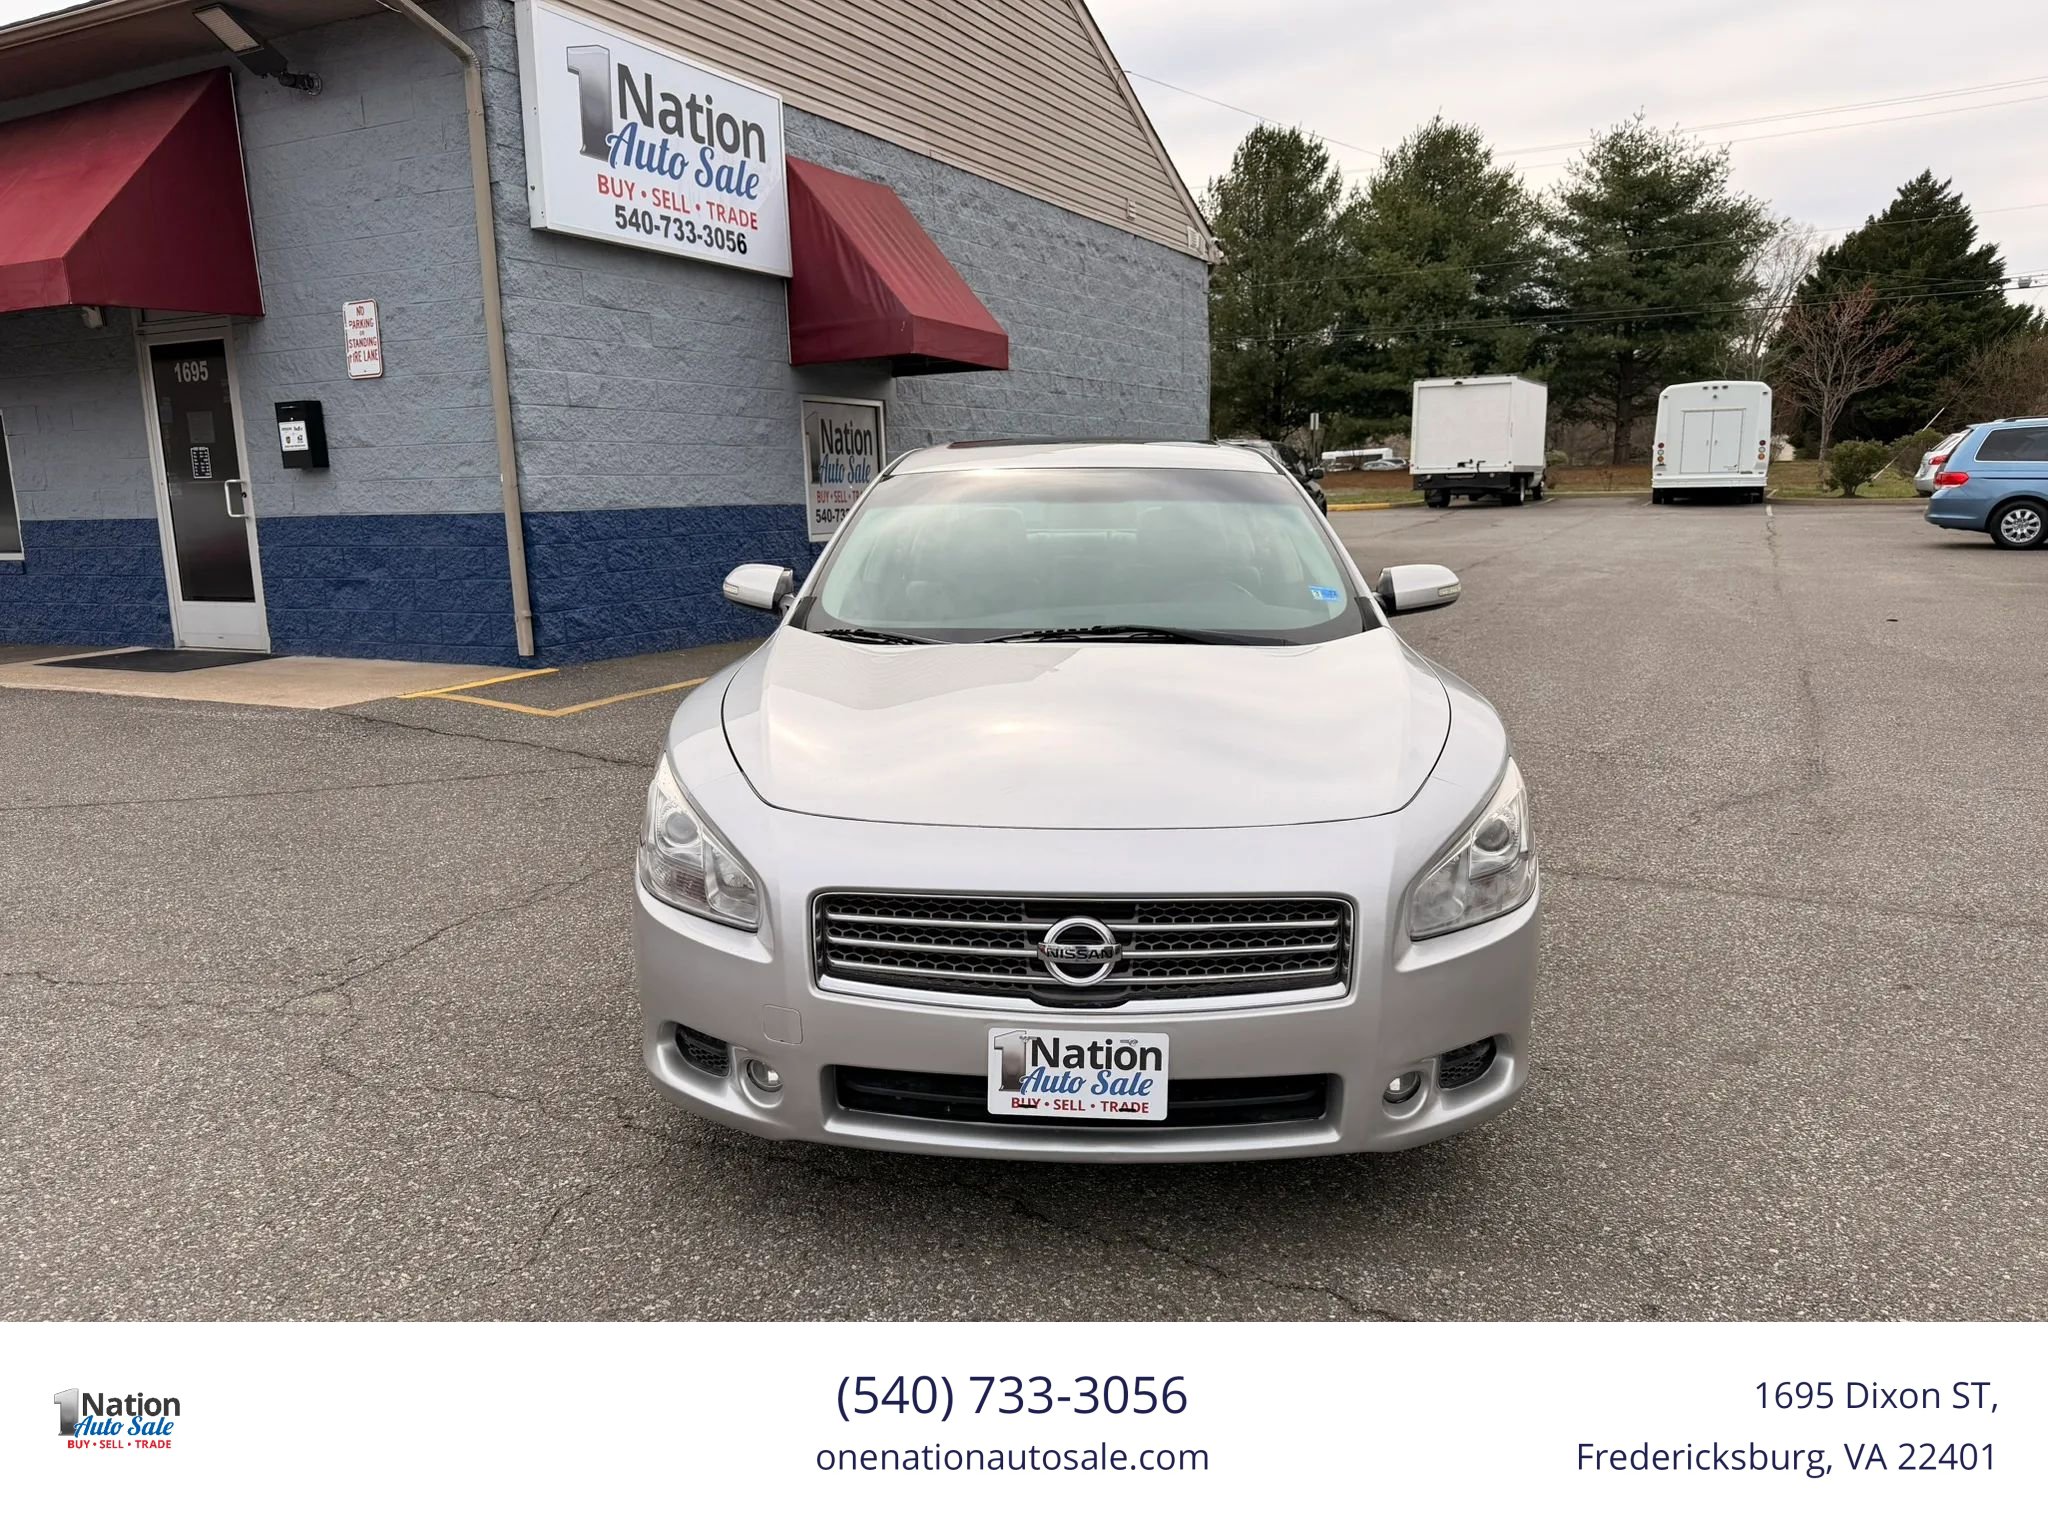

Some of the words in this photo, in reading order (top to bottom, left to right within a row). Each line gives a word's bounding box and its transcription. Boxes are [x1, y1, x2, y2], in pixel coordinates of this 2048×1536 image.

[617, 63, 766, 163] Nation
[606, 121, 690, 181] Auto
[694, 147, 759, 200] Sale
[597, 174, 635, 201] BUY
[652, 188, 690, 215] SELL
[708, 201, 758, 231] TRADE
[615, 205, 747, 255] 540-733-3056
[349, 318, 374, 329] PARKING
[356, 306, 364, 316] NO
[349, 337, 377, 348] STANDING
[363, 349, 378, 361] LANE
[174, 360, 209, 382] 1695
[821, 418, 872, 455] Nation
[819, 453, 845, 487] Auto
[848, 455, 871, 484] Sale
[817, 491, 830, 503] BUY
[834, 490, 848, 503] SELL
[1046, 949, 1113, 960] NISSAN
[1031, 1037, 1162, 1071] Nation
[1019, 1066, 1087, 1096] Auto
[1091, 1069, 1154, 1097] Sale
[1011, 1097, 1041, 1109] BUY
[1053, 1099, 1085, 1111] SELL
[1101, 1100, 1149, 1113] TRADE
